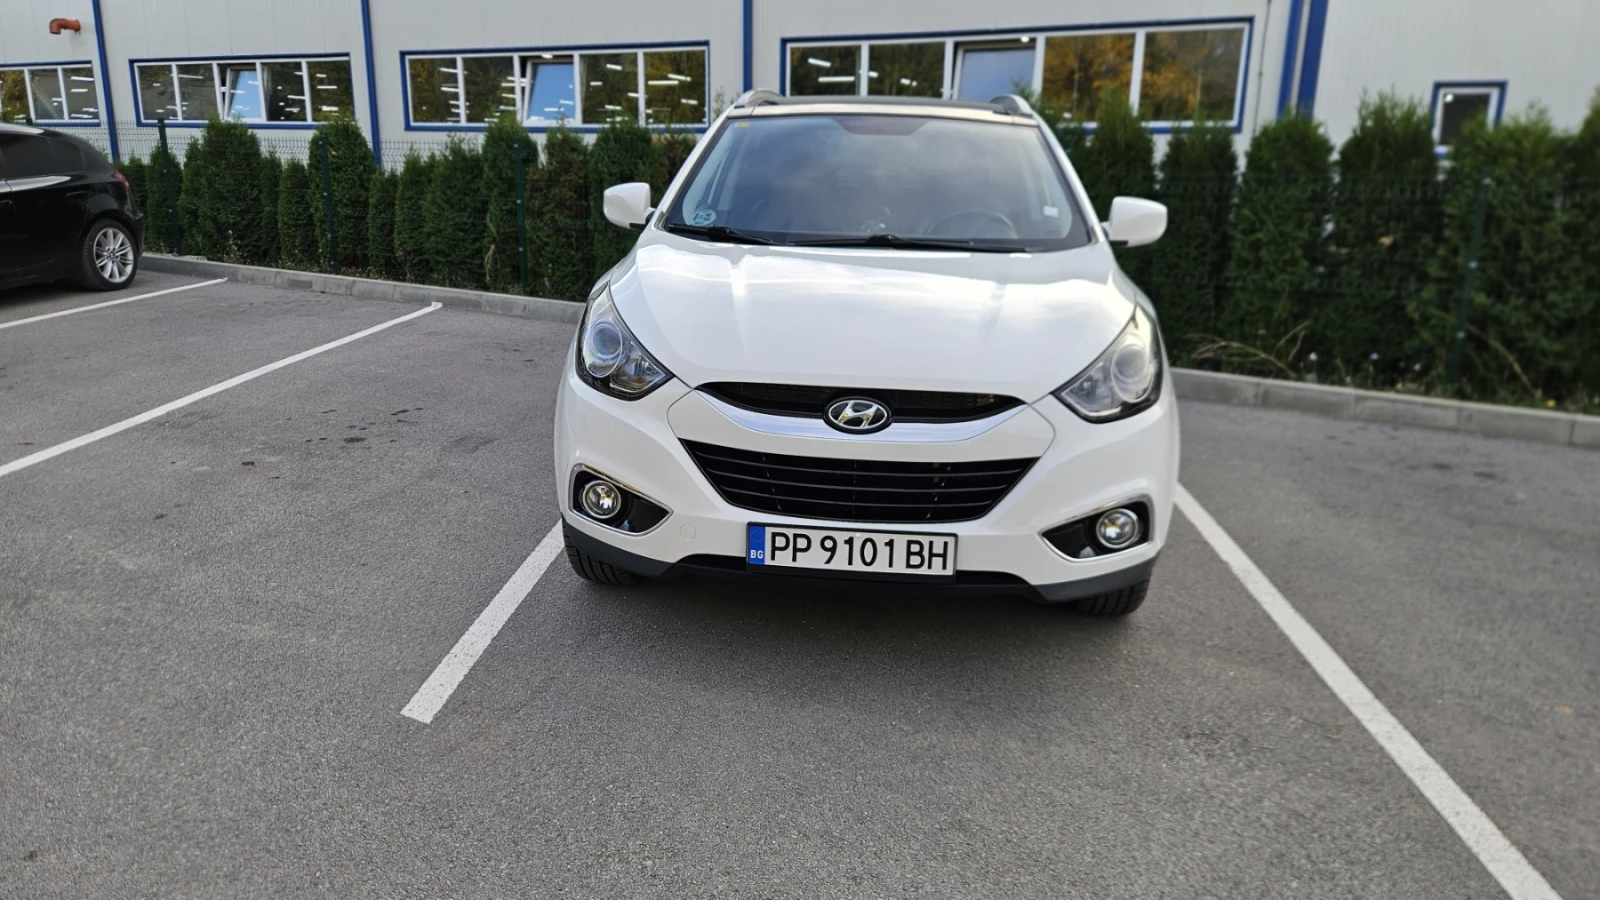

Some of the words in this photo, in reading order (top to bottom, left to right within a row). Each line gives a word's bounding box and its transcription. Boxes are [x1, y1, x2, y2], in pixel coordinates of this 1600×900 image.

[750, 549, 764, 559] BG
[770, 531, 812, 562] PP
[819, 535, 895, 568] 9101
[905, 539, 949, 570] BH
